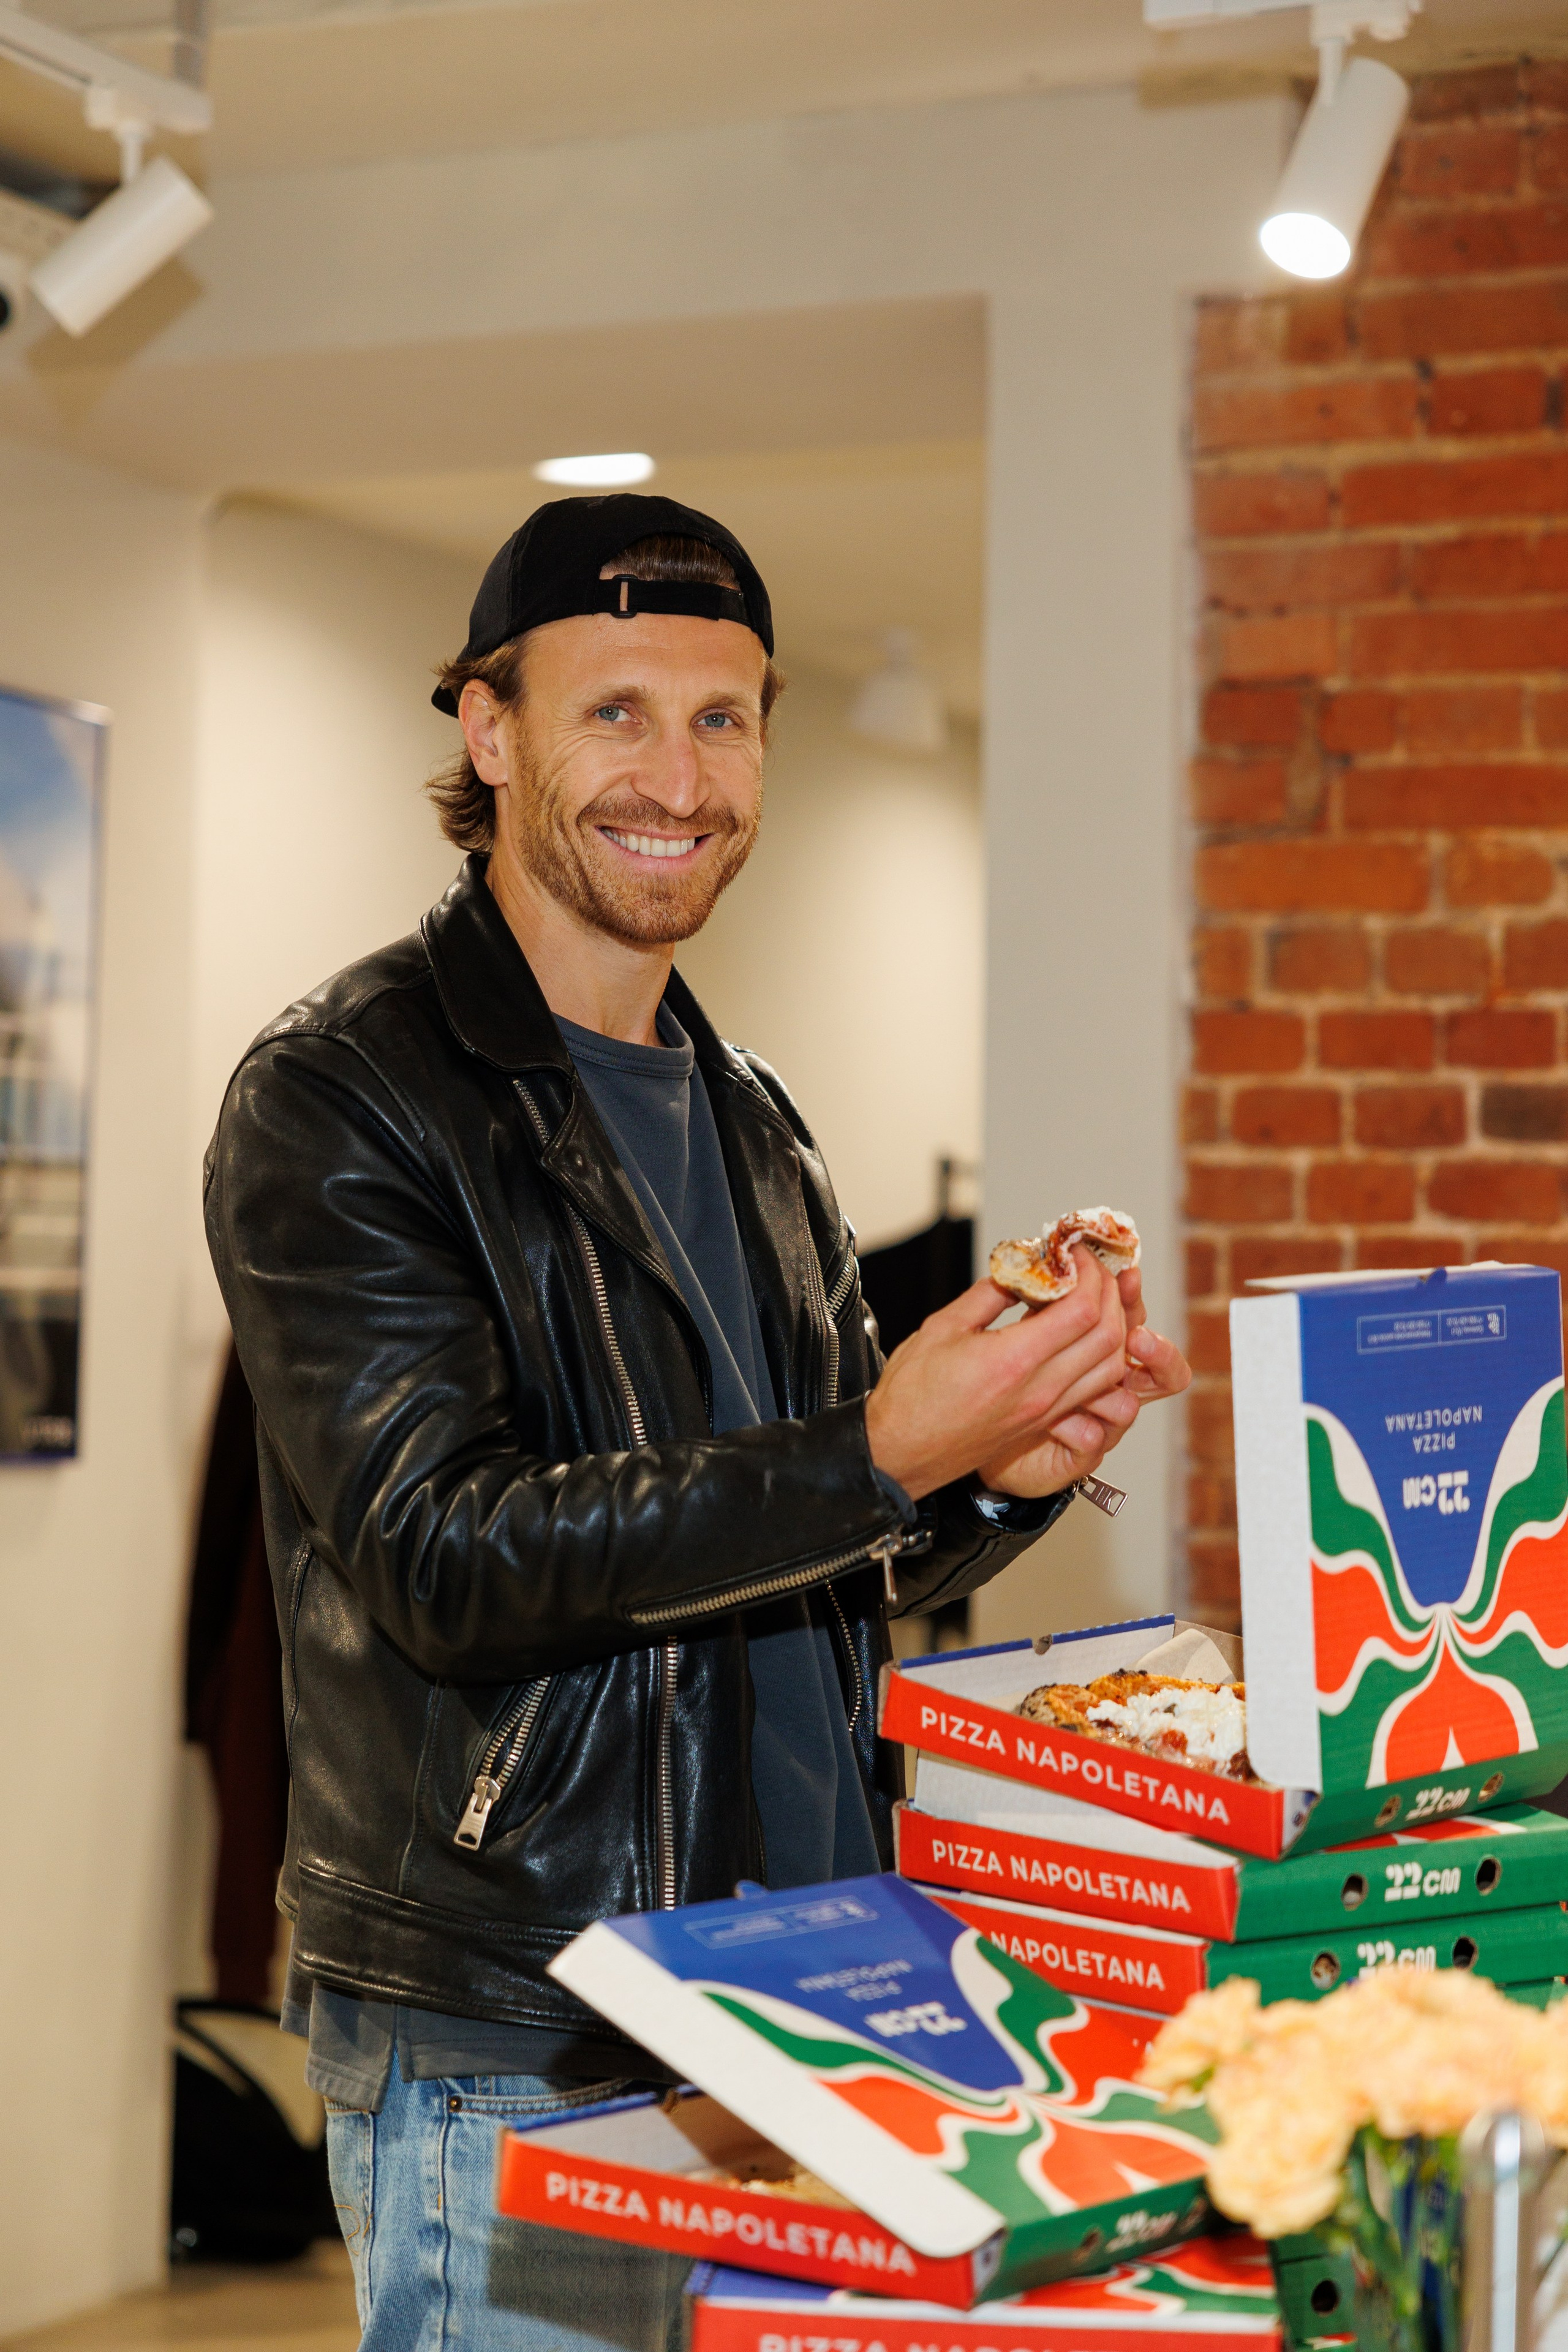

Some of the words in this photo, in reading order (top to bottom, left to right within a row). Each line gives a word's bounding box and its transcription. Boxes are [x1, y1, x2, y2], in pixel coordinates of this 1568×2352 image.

[1385, 1405, 1482, 1434] NAPOLETANA
[1412, 1430, 1455, 1454] PIZZA
[921, 1706, 1006, 1755] PIZZA
[1017, 1737, 1230, 1825] NAPOLETANA
[932, 1839, 1004, 1877] PIZZA
[1009, 1855, 1192, 1914] NAPOLETANA
[990, 1930, 1166, 1991] NAPOLETANA
[545, 2171, 650, 2222] PIZZA
[658, 2196, 918, 2277] NAPOLETANA
